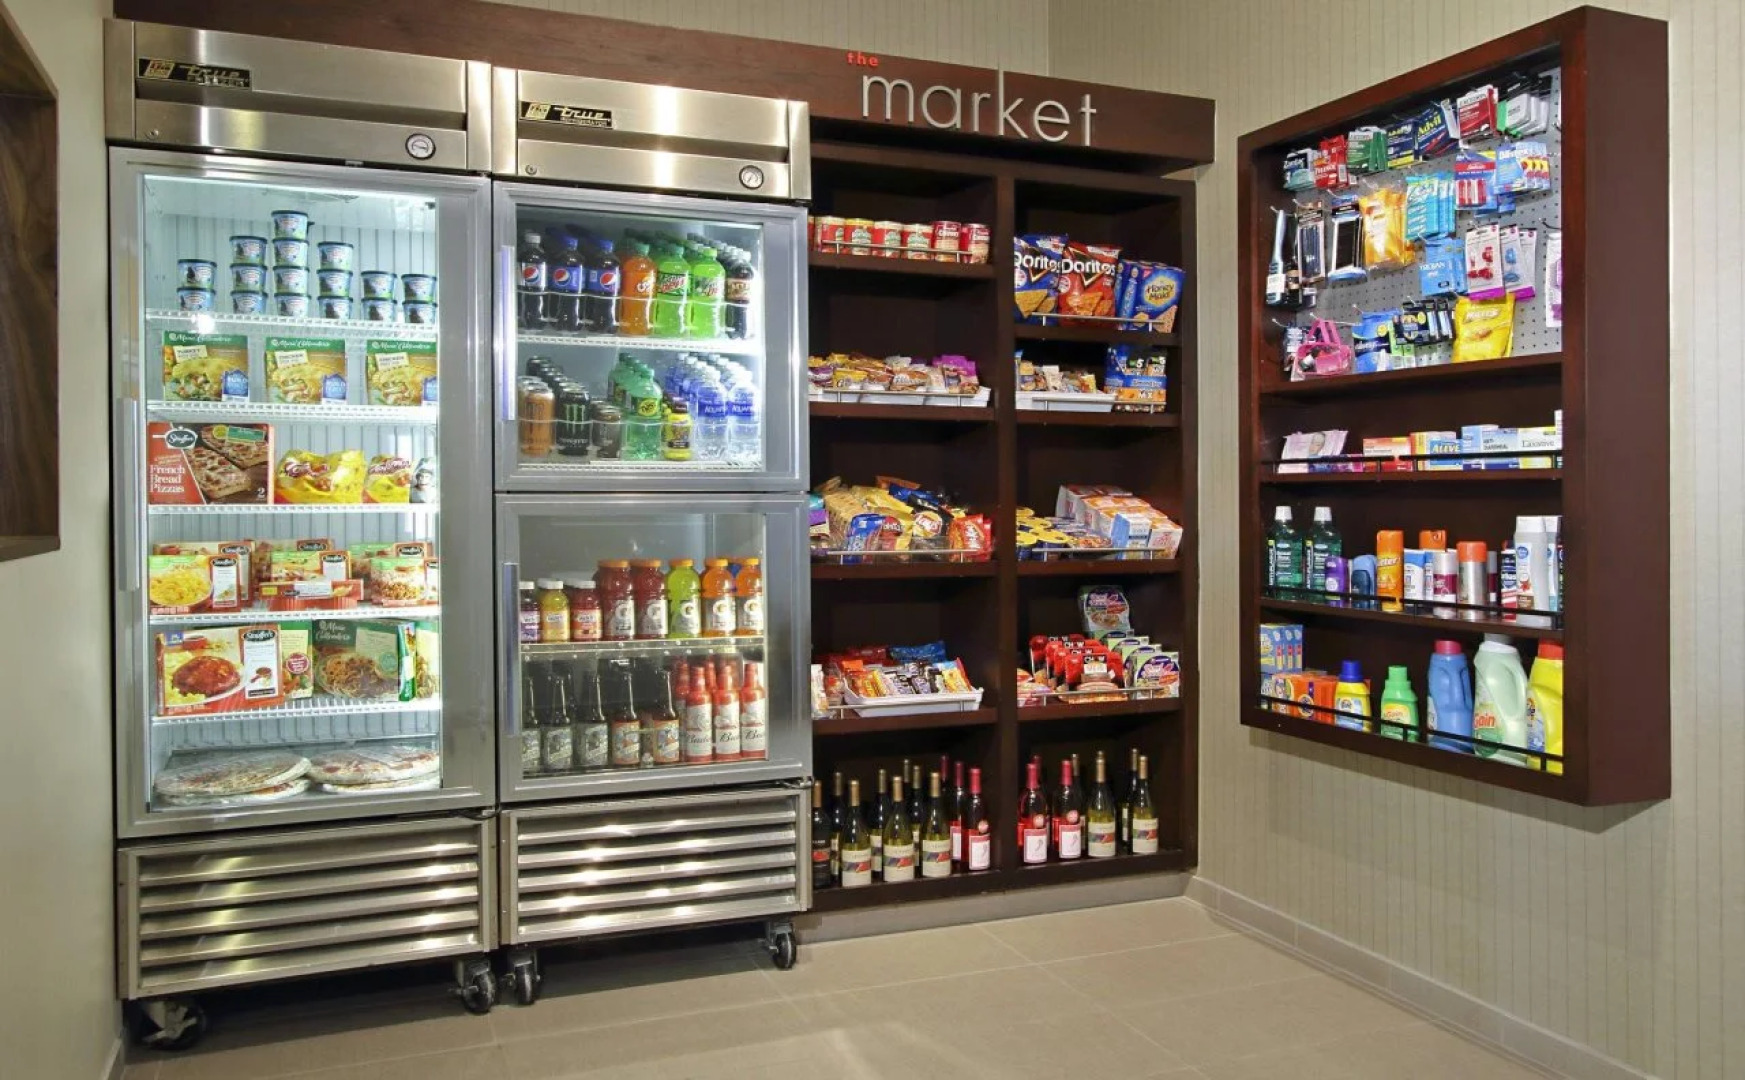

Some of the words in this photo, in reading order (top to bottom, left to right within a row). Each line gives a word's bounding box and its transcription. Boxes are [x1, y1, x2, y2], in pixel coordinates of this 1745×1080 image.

[847, 51, 880, 68] the
[554, 106, 610, 121] true
[862, 69, 1097, 147] market
[1417, 114, 1442, 136] Advil
[1061, 258, 1116, 276] Doritos
[1146, 282, 1174, 295] Honey
[1521, 440, 1555, 448] Laxative
[256, 487, 266, 498] 2
